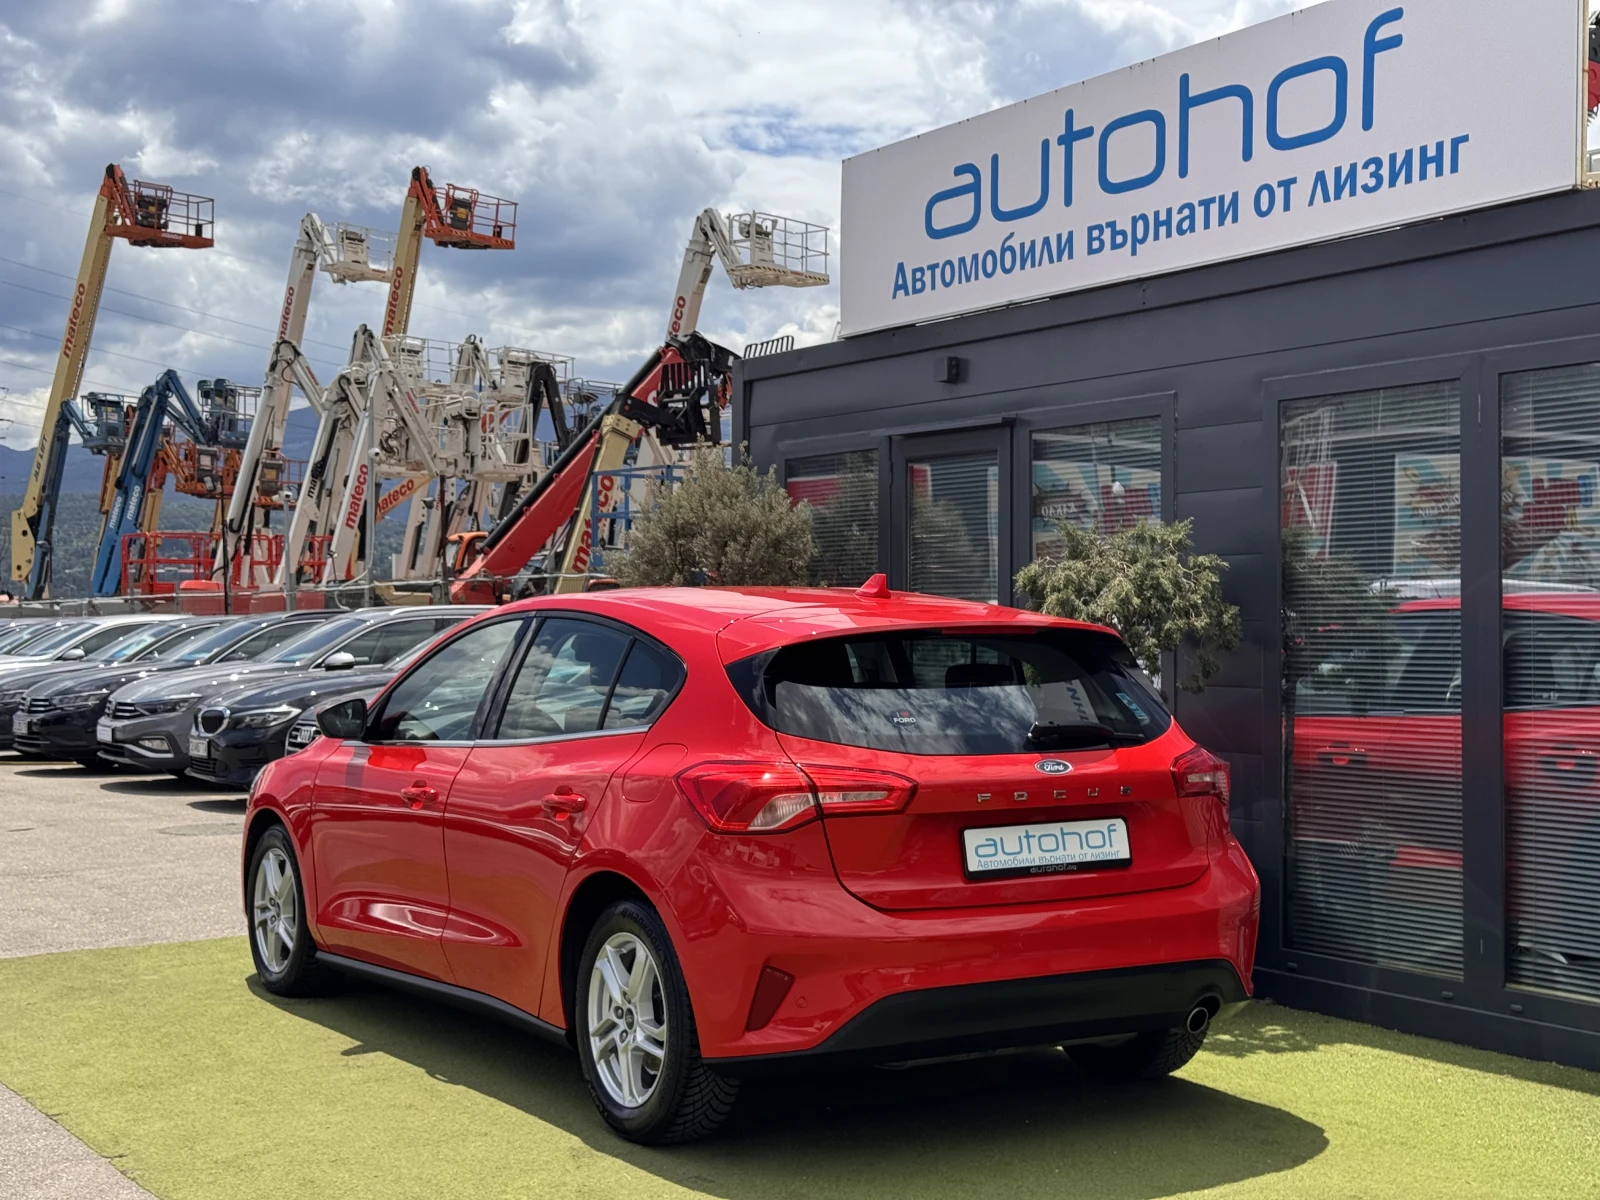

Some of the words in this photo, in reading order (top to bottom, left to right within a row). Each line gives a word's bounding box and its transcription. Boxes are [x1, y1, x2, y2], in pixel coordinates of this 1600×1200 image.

[925, 7, 1403, 240] autohof
[892, 231, 1074, 300] Автомобили
[1087, 191, 1239, 256] върнати
[1253, 176, 1297, 218] от
[1308, 134, 1469, 207] лизинг
[62, 282, 86, 359] mateco
[40, 434, 48, 460] LIFT
[109, 496, 122, 529] mateco
[126, 485, 140, 520] mateco
[345, 463, 369, 530] mateco
[1043, 762, 1065, 771] Ford
[977, 785, 1132, 803] FOCUS
[974, 823, 1117, 858] autohof
[977, 855, 1036, 869] Автомобили
[1038, 852, 1077, 865] върнати
[1078, 853, 1088, 861] от
[1090, 850, 1120, 860] лизинг
[1030, 863, 1077, 874] autohof.bg
